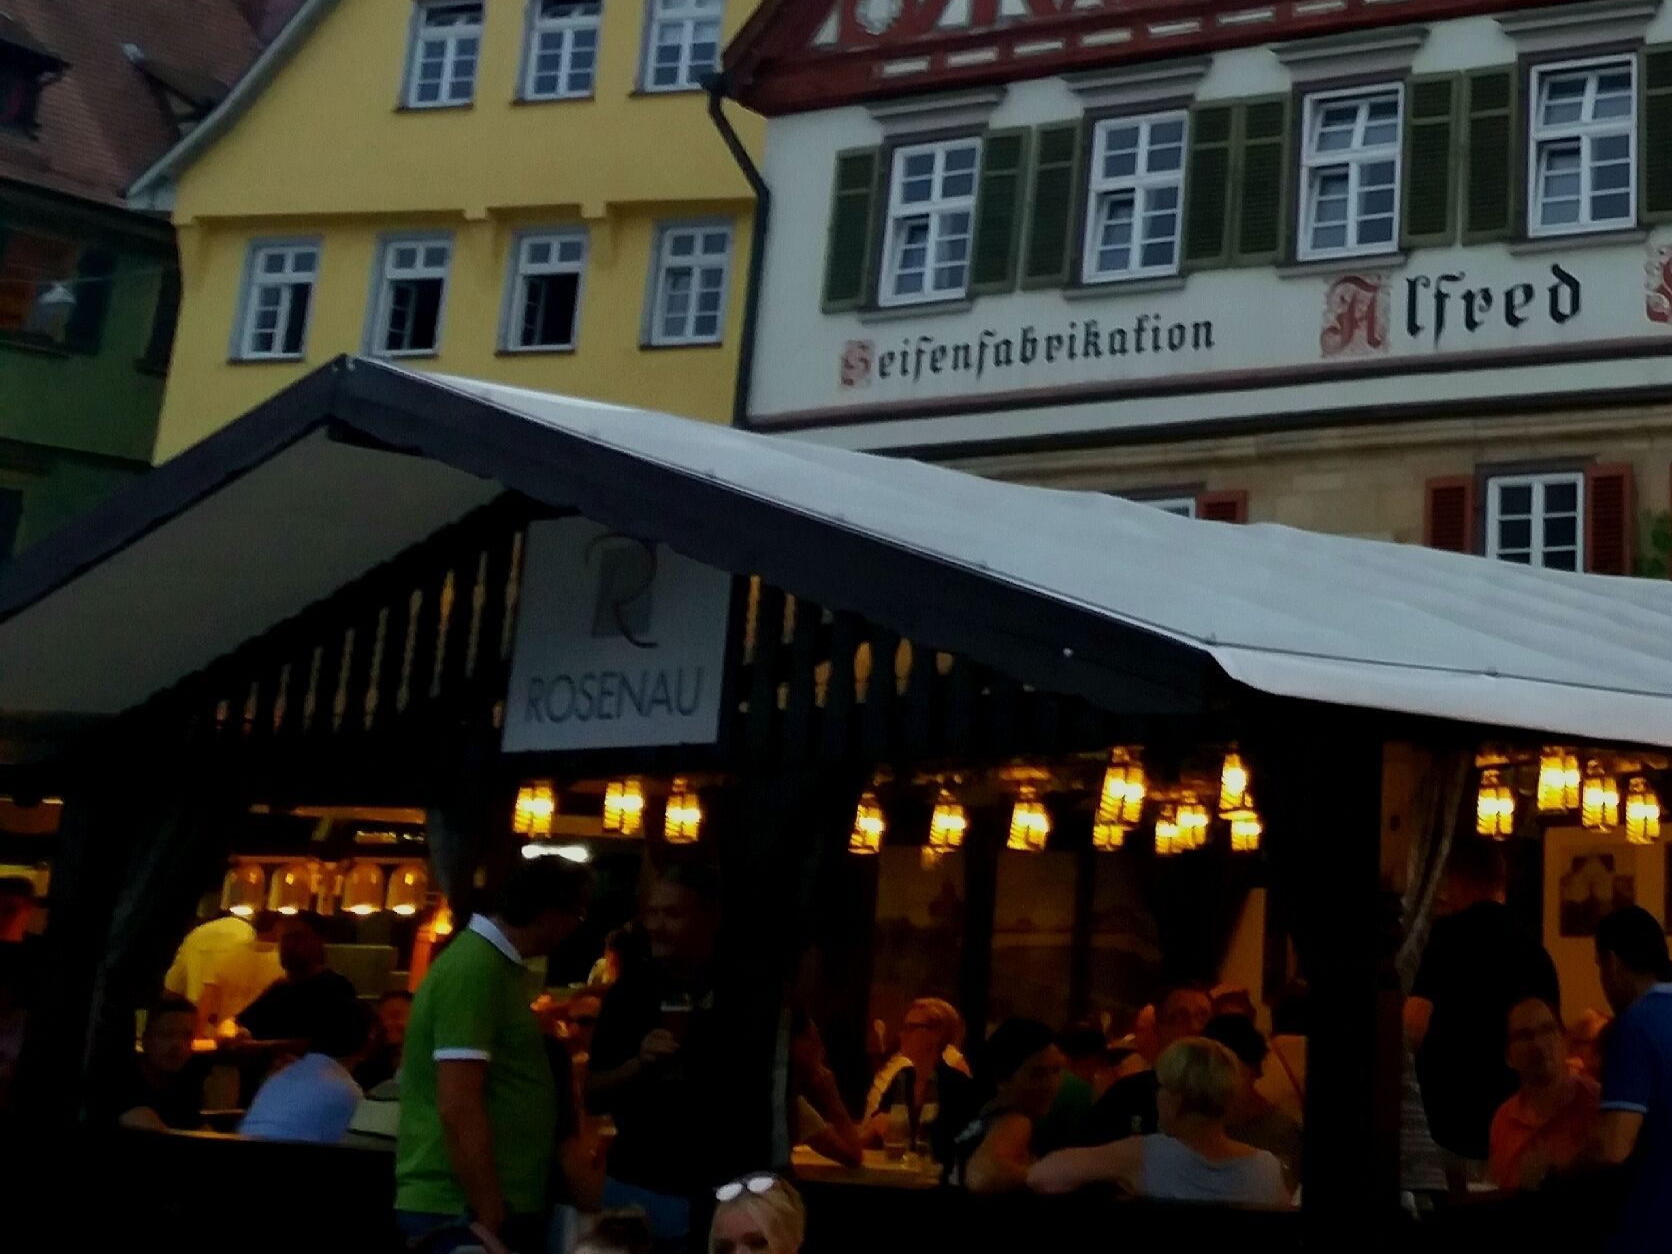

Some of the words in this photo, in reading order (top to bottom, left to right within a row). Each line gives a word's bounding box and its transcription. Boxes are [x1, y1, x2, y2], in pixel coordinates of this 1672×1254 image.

[839, 317, 1215, 389] Seifenfabrikation
[1320, 263, 1583, 359] Alfred
[523, 666, 705, 724] ROSENAU
